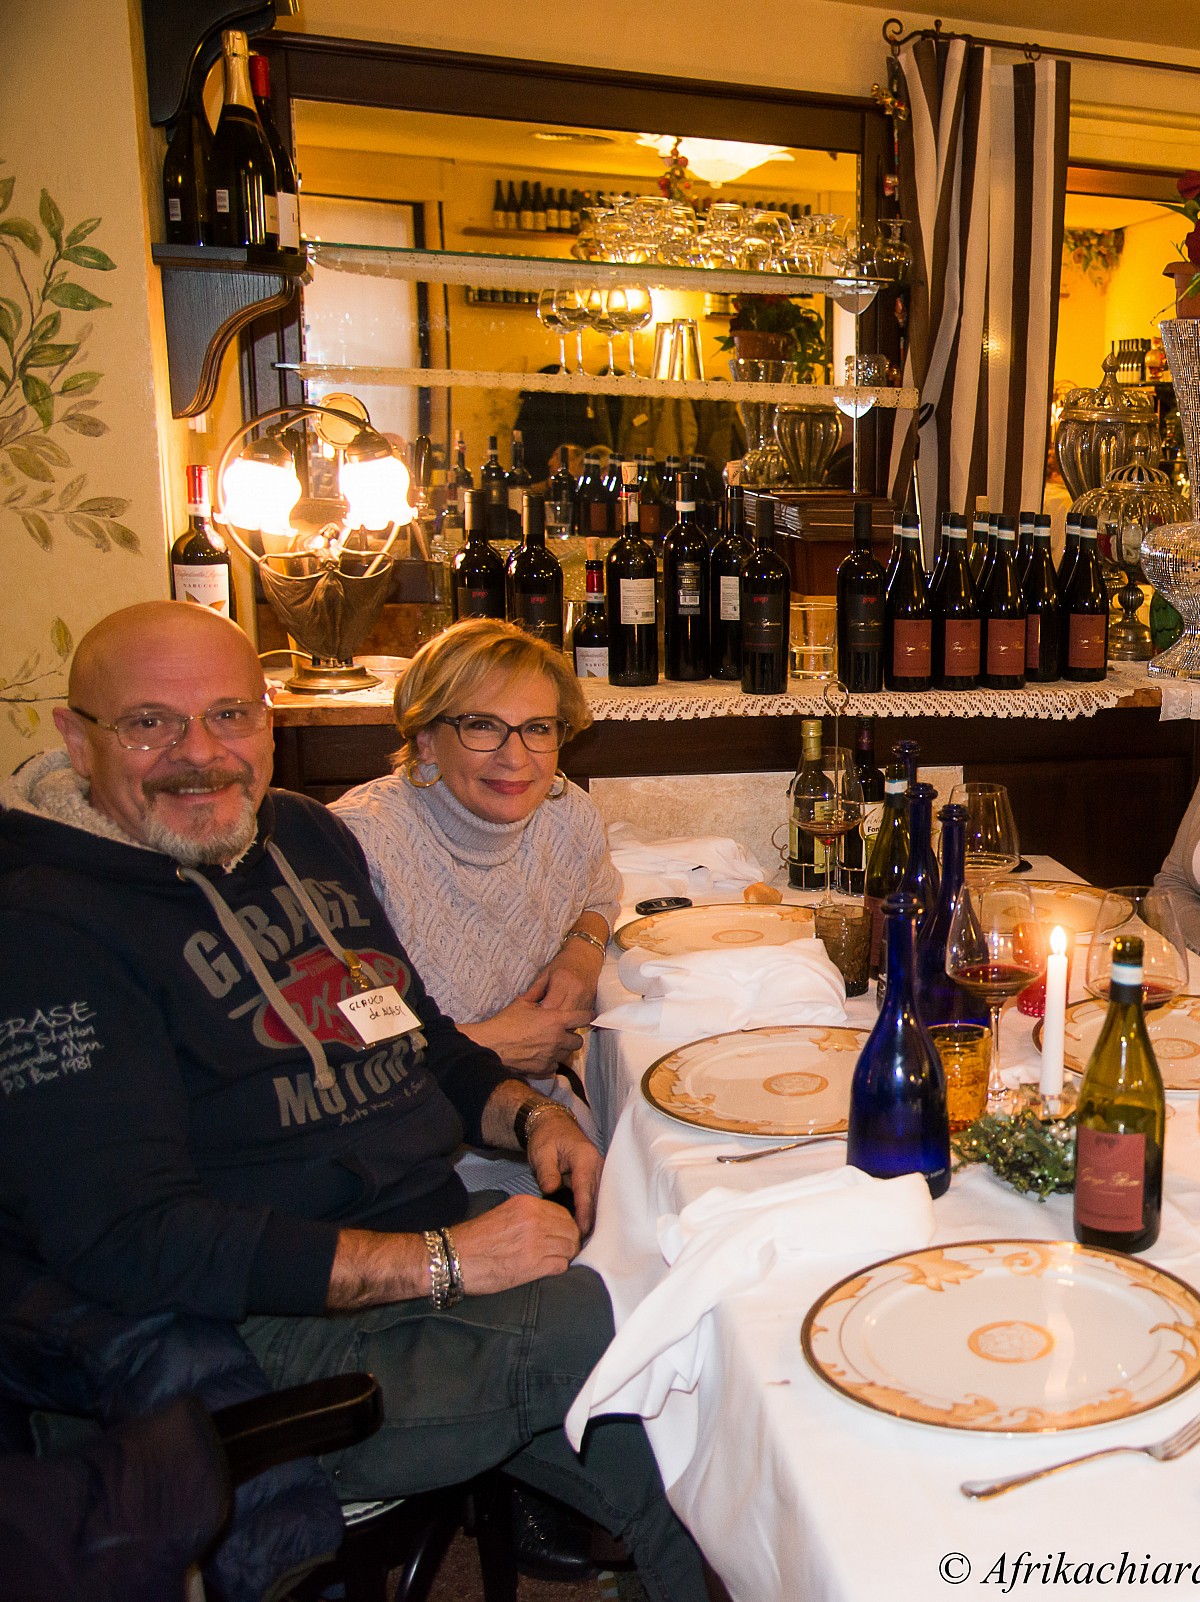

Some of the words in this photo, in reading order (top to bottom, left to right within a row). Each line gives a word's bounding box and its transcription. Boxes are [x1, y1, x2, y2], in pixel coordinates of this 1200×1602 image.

[184, 878, 371, 999] GRAGE
[349, 995, 384, 1012] GLAUCO
[61, 1054, 92, 1074] 1981
